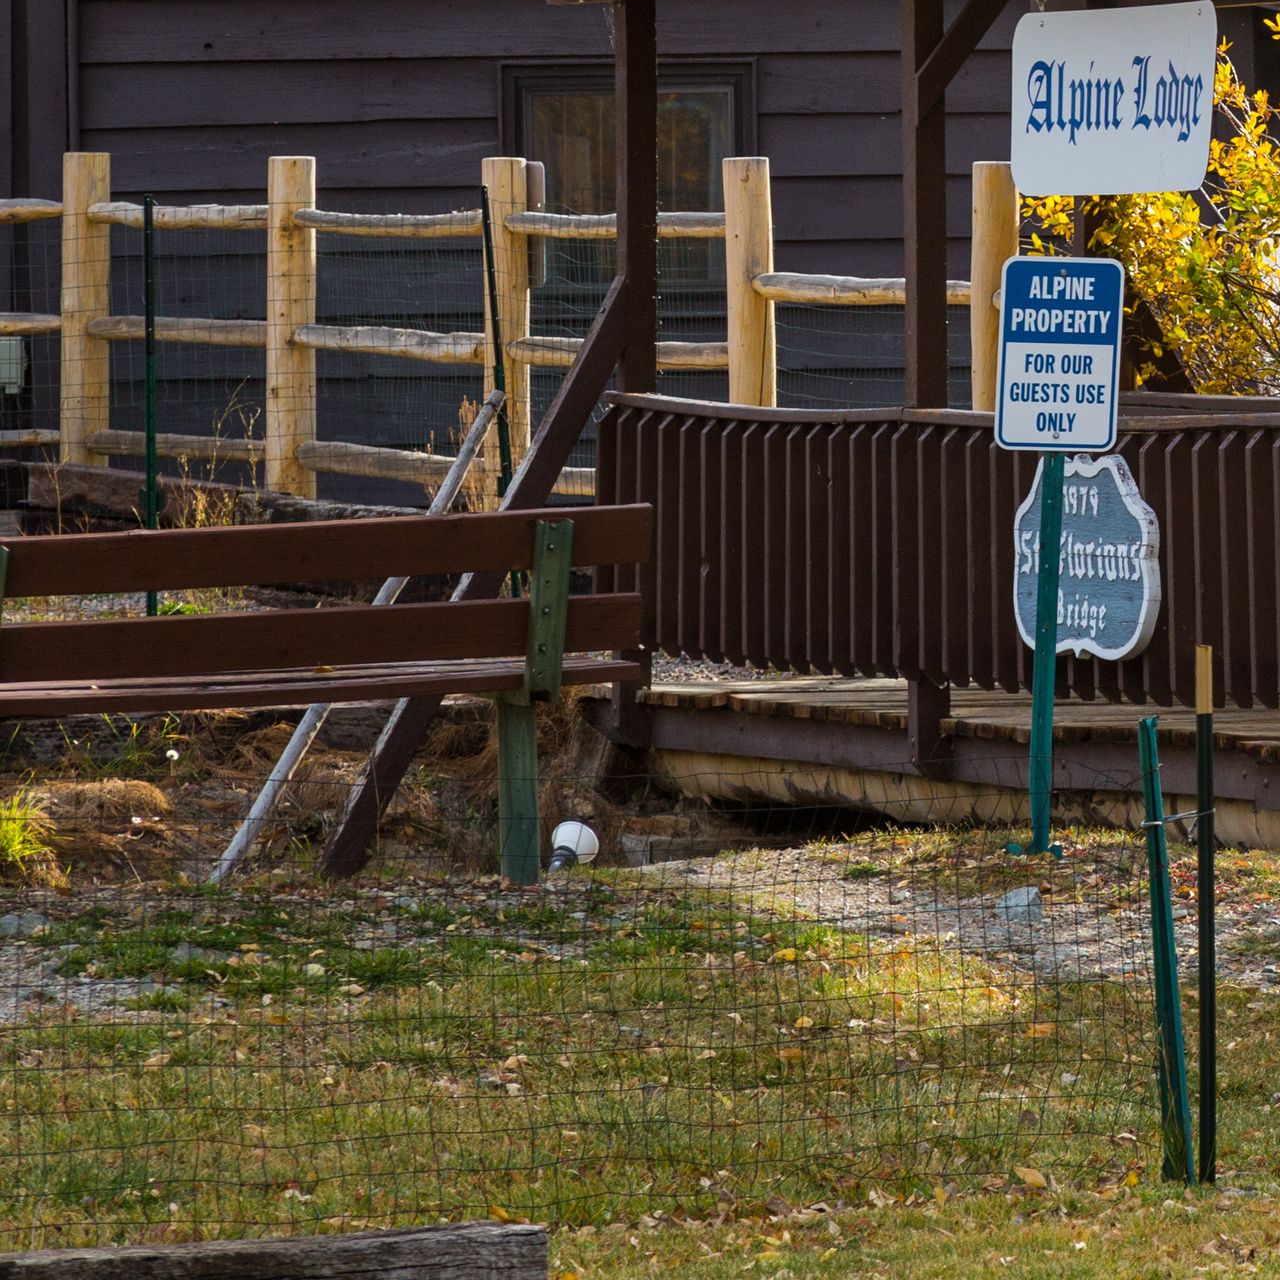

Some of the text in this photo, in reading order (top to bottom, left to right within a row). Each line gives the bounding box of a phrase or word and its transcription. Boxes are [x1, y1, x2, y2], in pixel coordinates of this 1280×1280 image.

[1026, 55, 1204, 146] Alpine Lodge
[1029, 276, 1095, 300] ALPINE
[1011, 308, 1111, 333] PROPERTY
[1024, 353, 1093, 375] FOR OUR
[1009, 382, 1106, 404] GUESTS USE
[1036, 412, 1077, 432] ONLY
